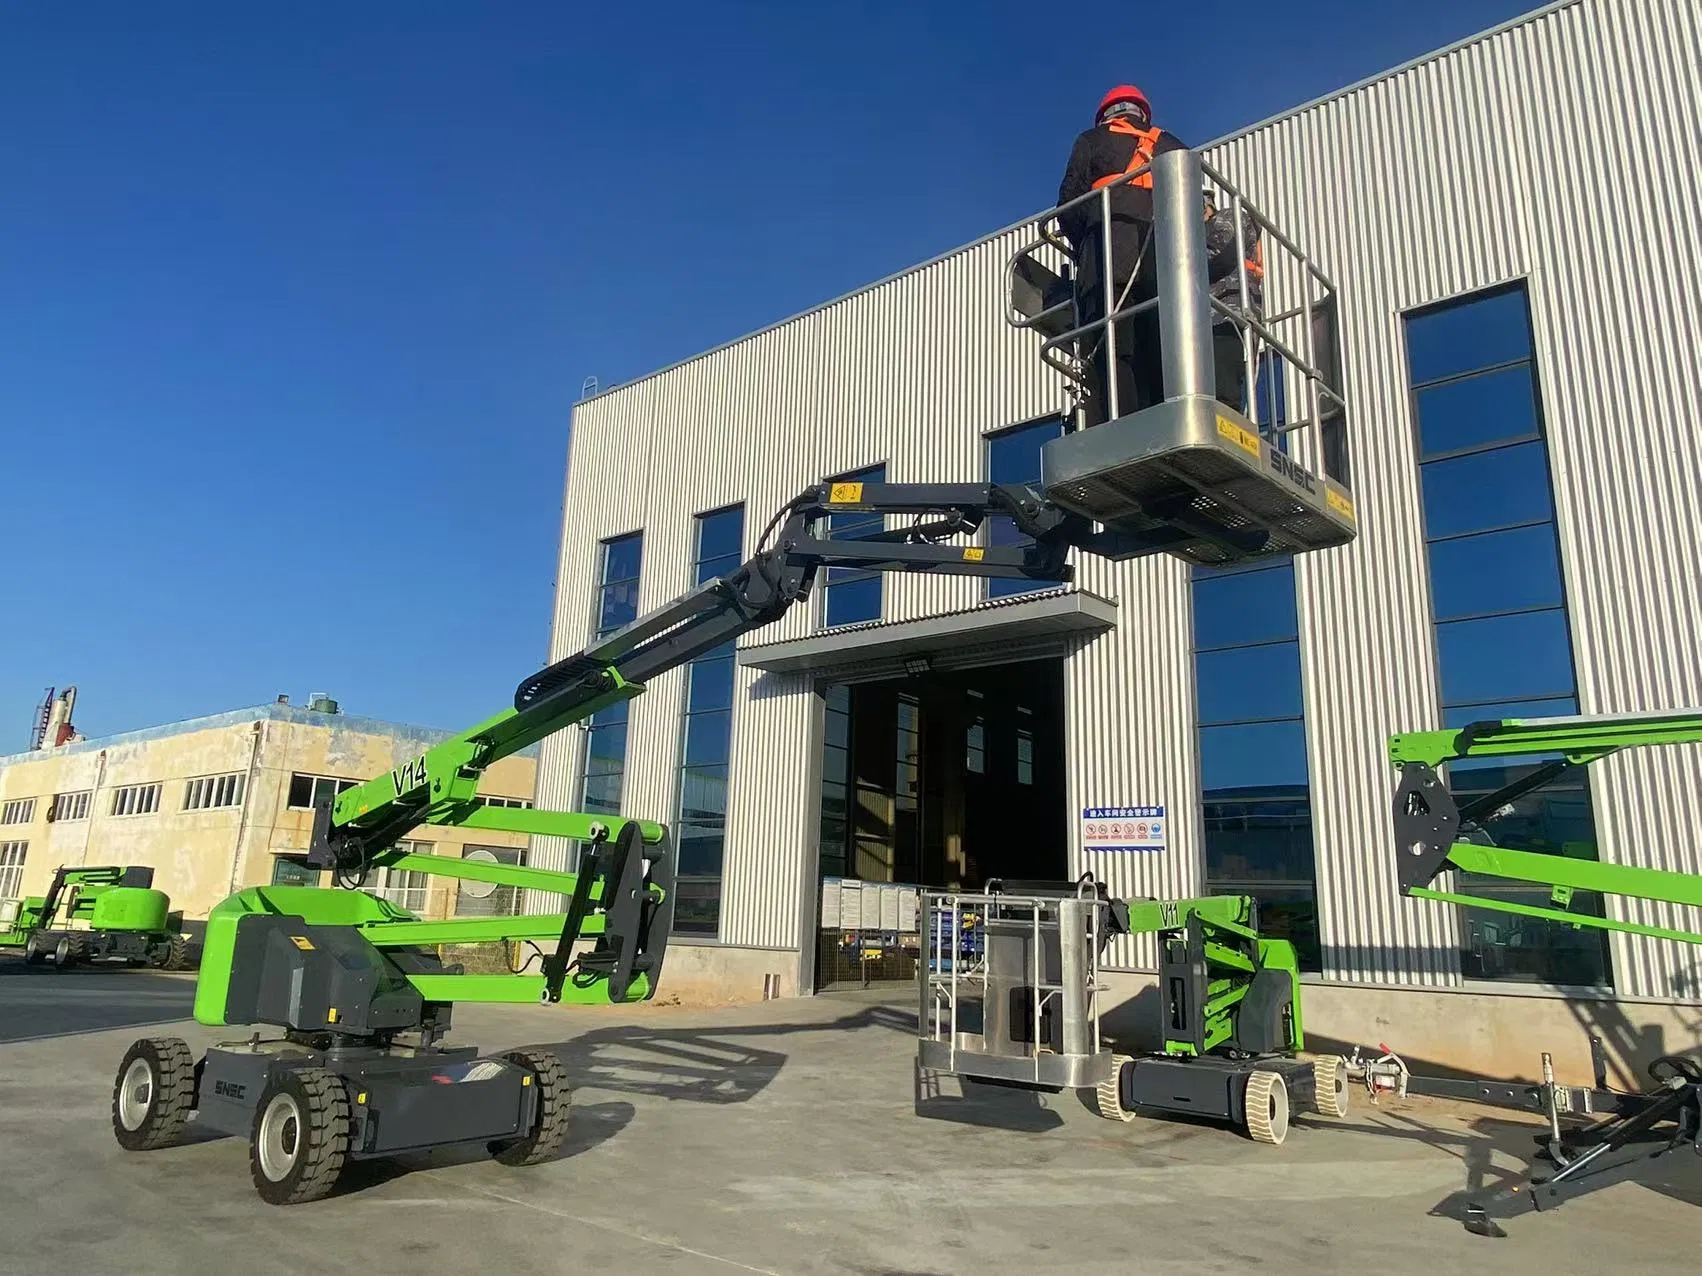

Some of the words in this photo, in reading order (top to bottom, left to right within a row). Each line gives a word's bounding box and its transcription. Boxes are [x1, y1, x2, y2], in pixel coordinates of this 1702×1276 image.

[1270, 448, 1316, 496] SNSC
[391, 754, 428, 797] V14
[1159, 902, 1180, 928] V11
